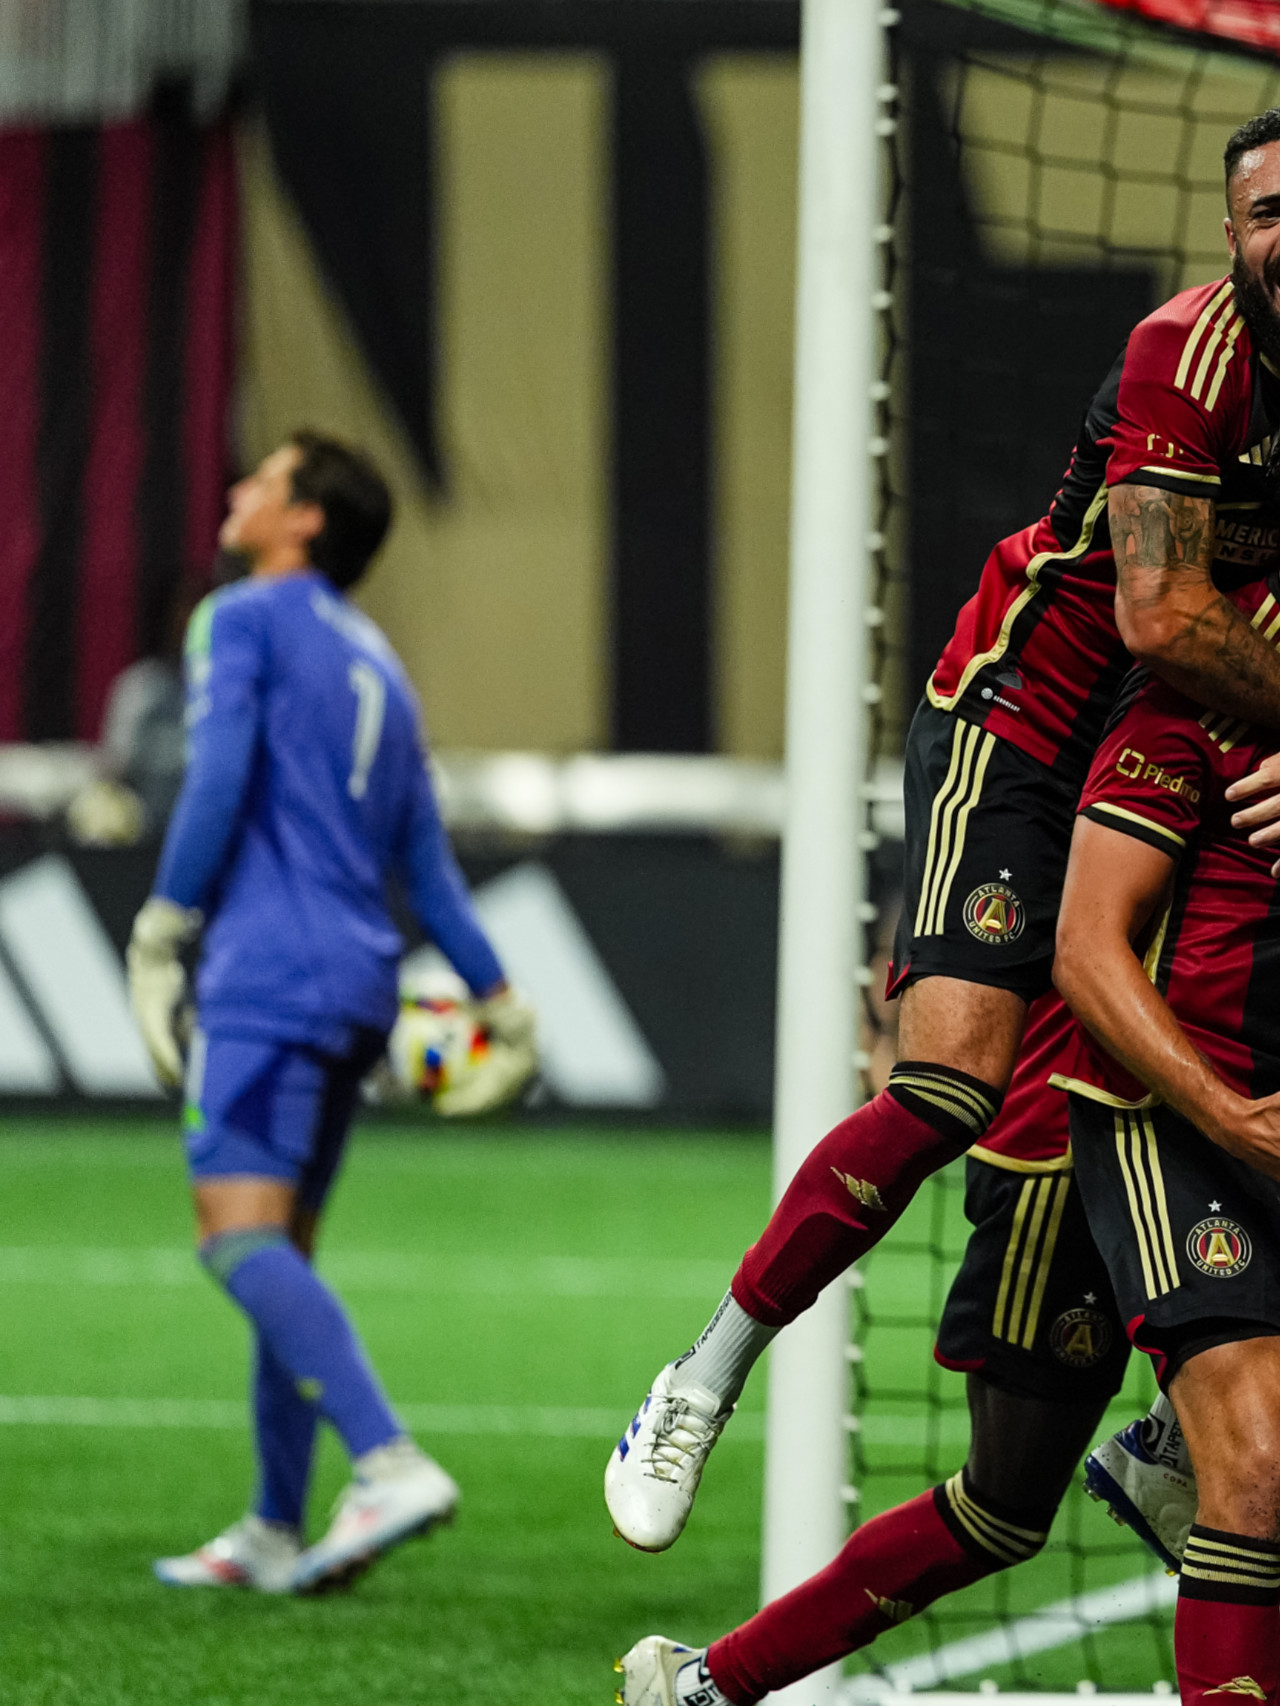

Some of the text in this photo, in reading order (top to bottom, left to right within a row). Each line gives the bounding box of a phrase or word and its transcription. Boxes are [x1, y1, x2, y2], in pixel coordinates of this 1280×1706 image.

[1215, 518, 1279, 548] MERIC
[348, 662, 387, 799] 1
[1143, 763, 1201, 804] Piedmo
[977, 885, 1021, 908] ATLANTA
[968, 920, 1016, 944] UNITED FC
[1195, 1219, 1240, 1236] ATLANTA
[1196, 1259, 1246, 1277] UNITED FC
[1163, 1473, 1188, 1487] COPA
